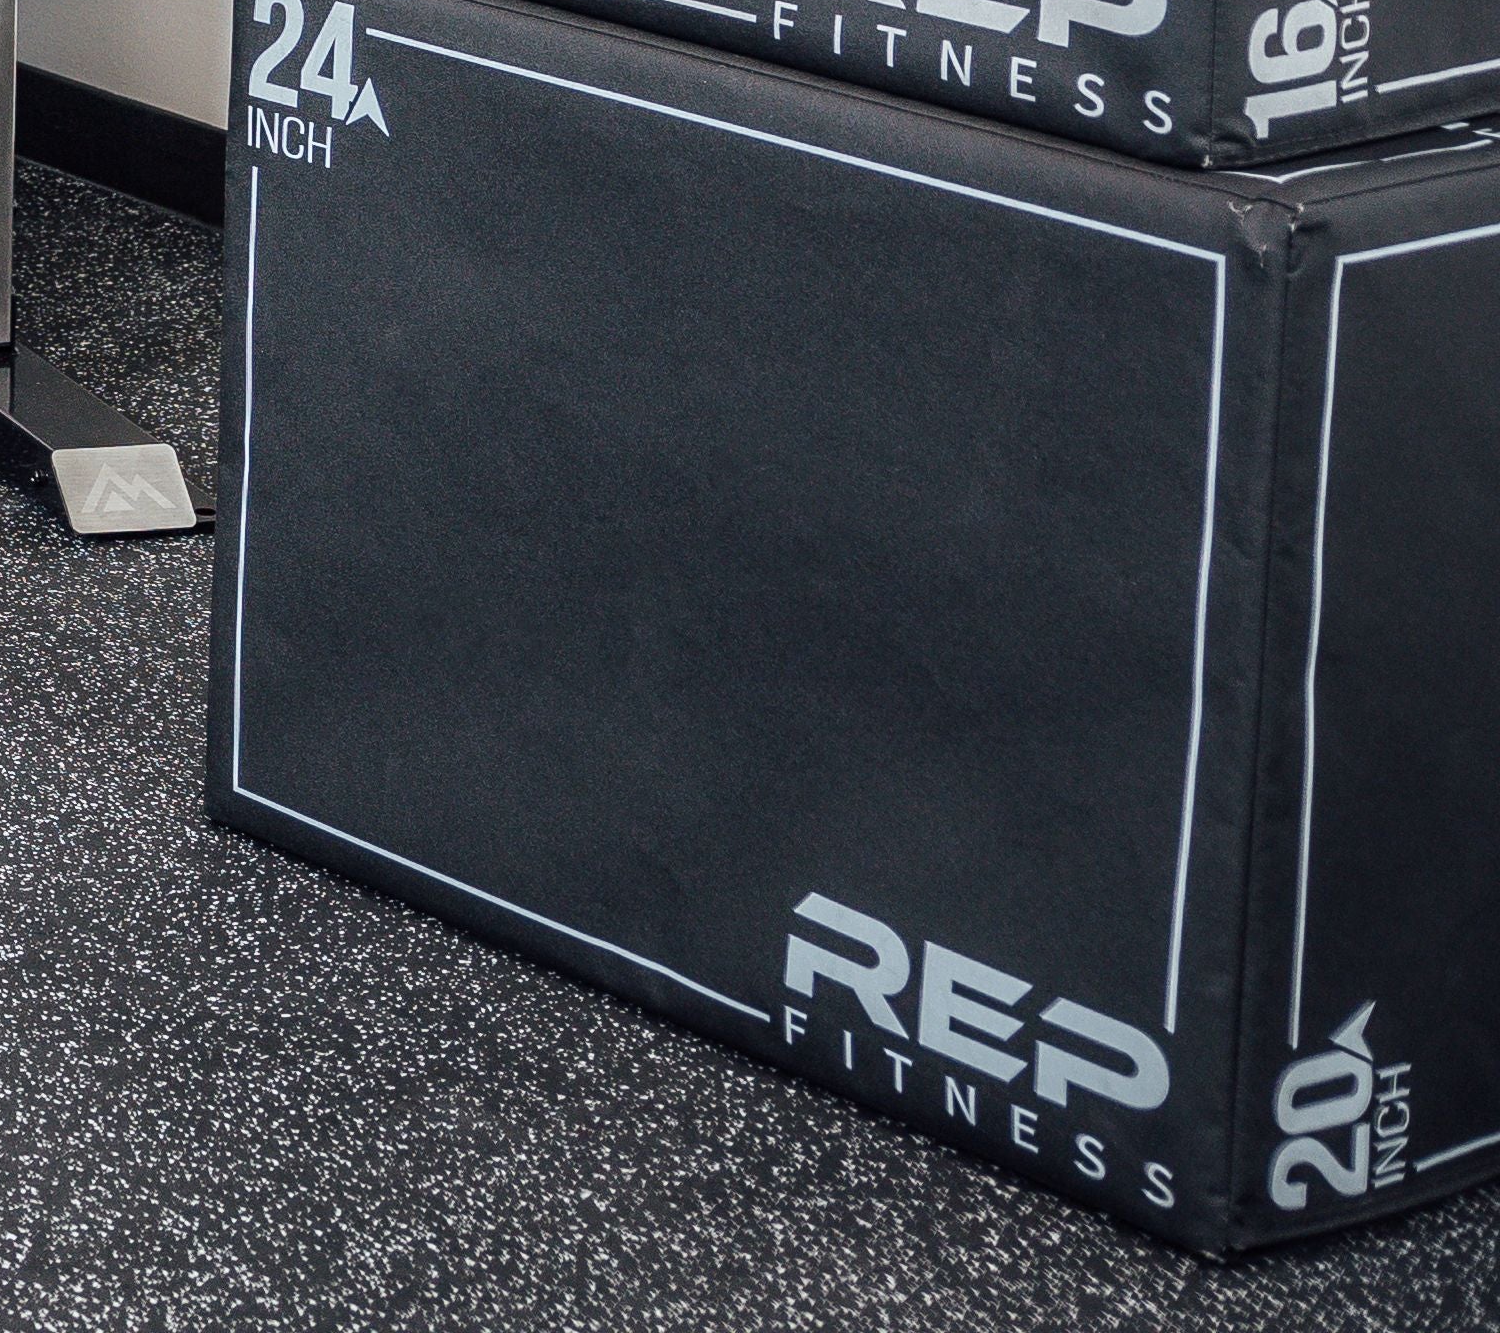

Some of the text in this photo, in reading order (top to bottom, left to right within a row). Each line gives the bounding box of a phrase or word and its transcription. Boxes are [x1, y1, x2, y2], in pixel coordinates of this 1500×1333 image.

[247, 105, 333, 169] INCH
[773, 0, 1174, 135] FITNESS
[1244, 0, 1339, 139] 16
[783, 891, 1170, 1109] REP
[783, 1004, 1176, 1209] FITNESS
[1270, 1047, 1375, 1211] 20
[1373, 1062, 1413, 1190] INCH
